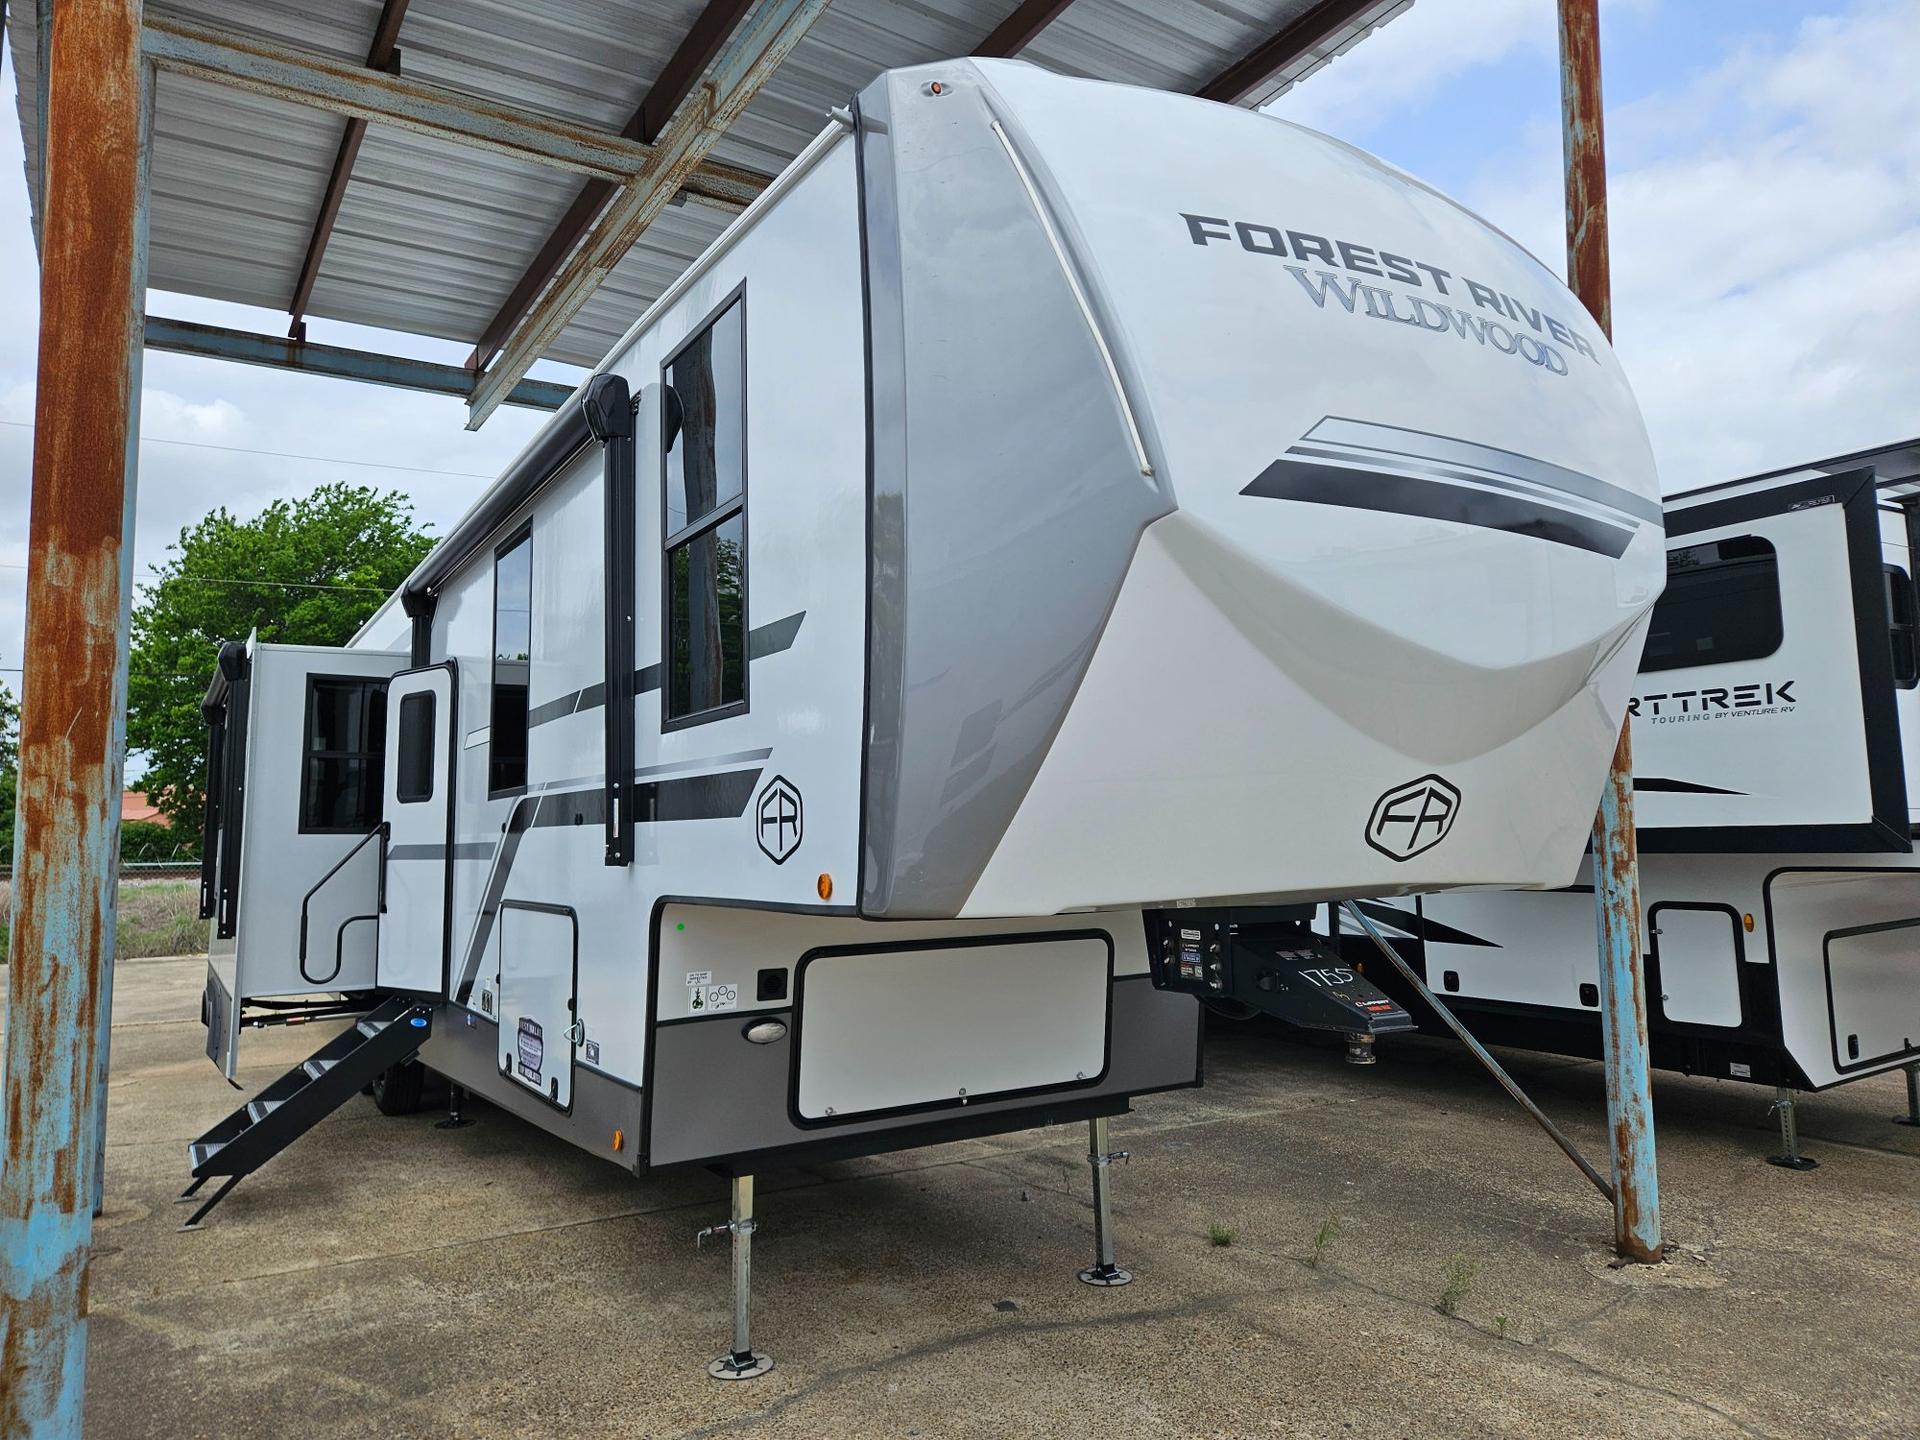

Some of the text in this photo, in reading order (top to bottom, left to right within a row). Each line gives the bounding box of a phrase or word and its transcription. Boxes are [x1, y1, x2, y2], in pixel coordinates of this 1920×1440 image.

[1179, 213, 1602, 366] FOREST RIVER
[1283, 264, 1569, 377] WILDWOOD
[1651, 705, 1796, 725] TOURING BY VENTURE RV
[1297, 967, 1354, 987] 1755
